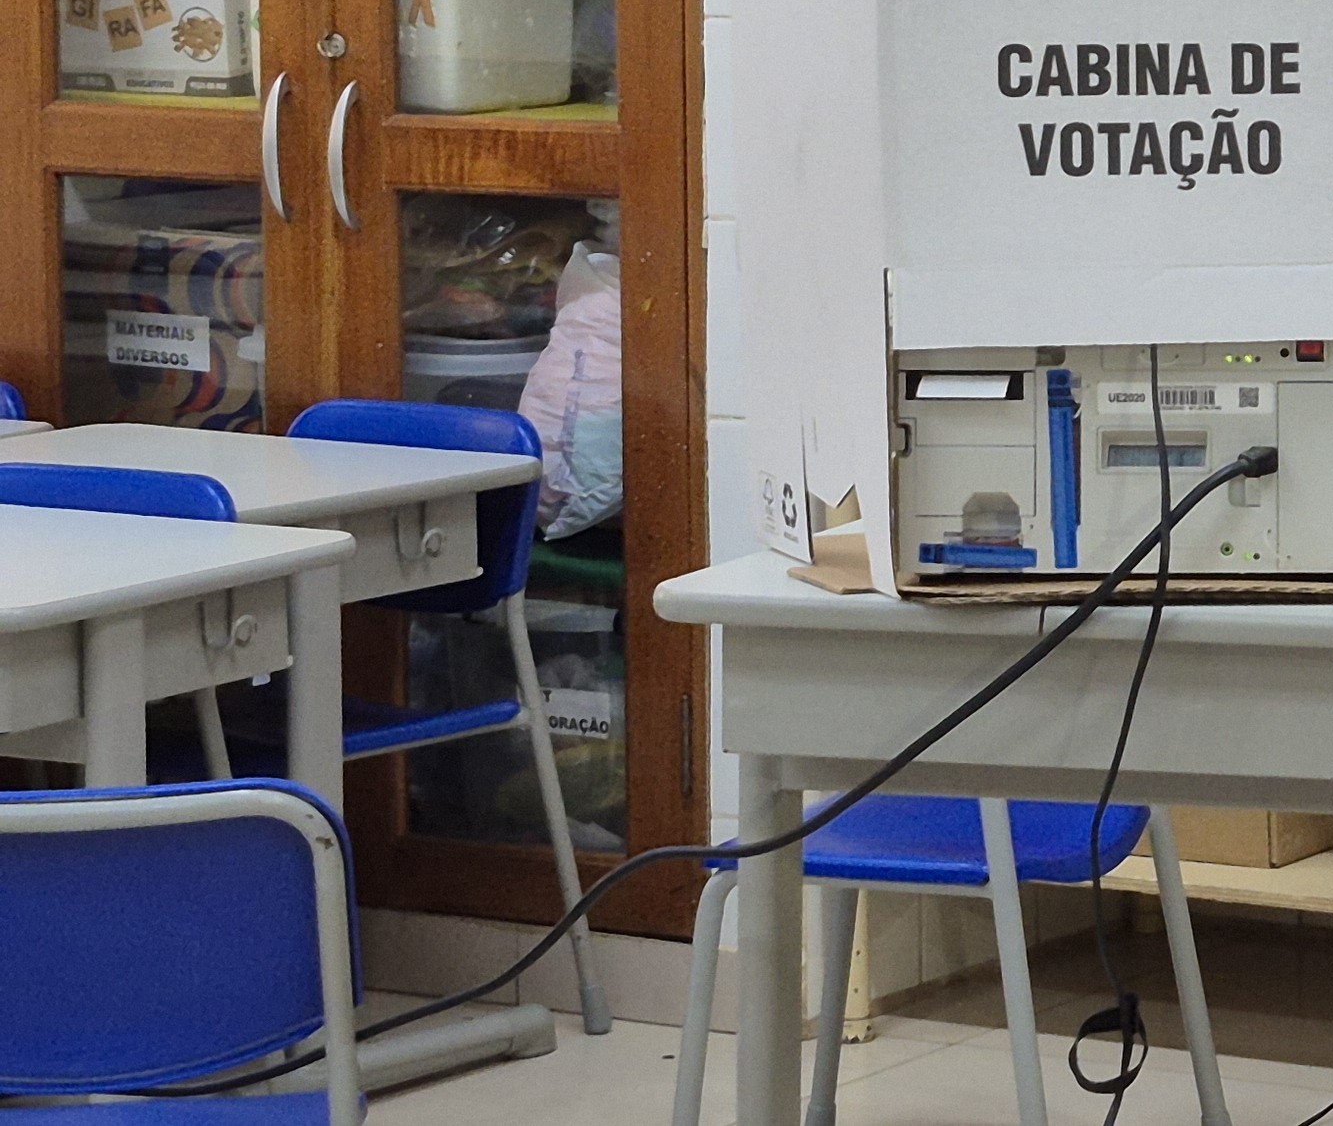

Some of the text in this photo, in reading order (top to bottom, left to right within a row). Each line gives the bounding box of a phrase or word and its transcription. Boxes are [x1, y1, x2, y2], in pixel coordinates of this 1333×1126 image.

[109, 17, 141, 38] RA
[997, 42, 1301, 98] CABINA DE
[1018, 107, 1283, 191] VOTAÇÃO
[114, 320, 197, 343] MATERIAIS
[115, 347, 191, 367] DIVERSOS
[1108, 392, 1146, 404] UE2020
[548, 715, 610, 735] ORAÇÃO
